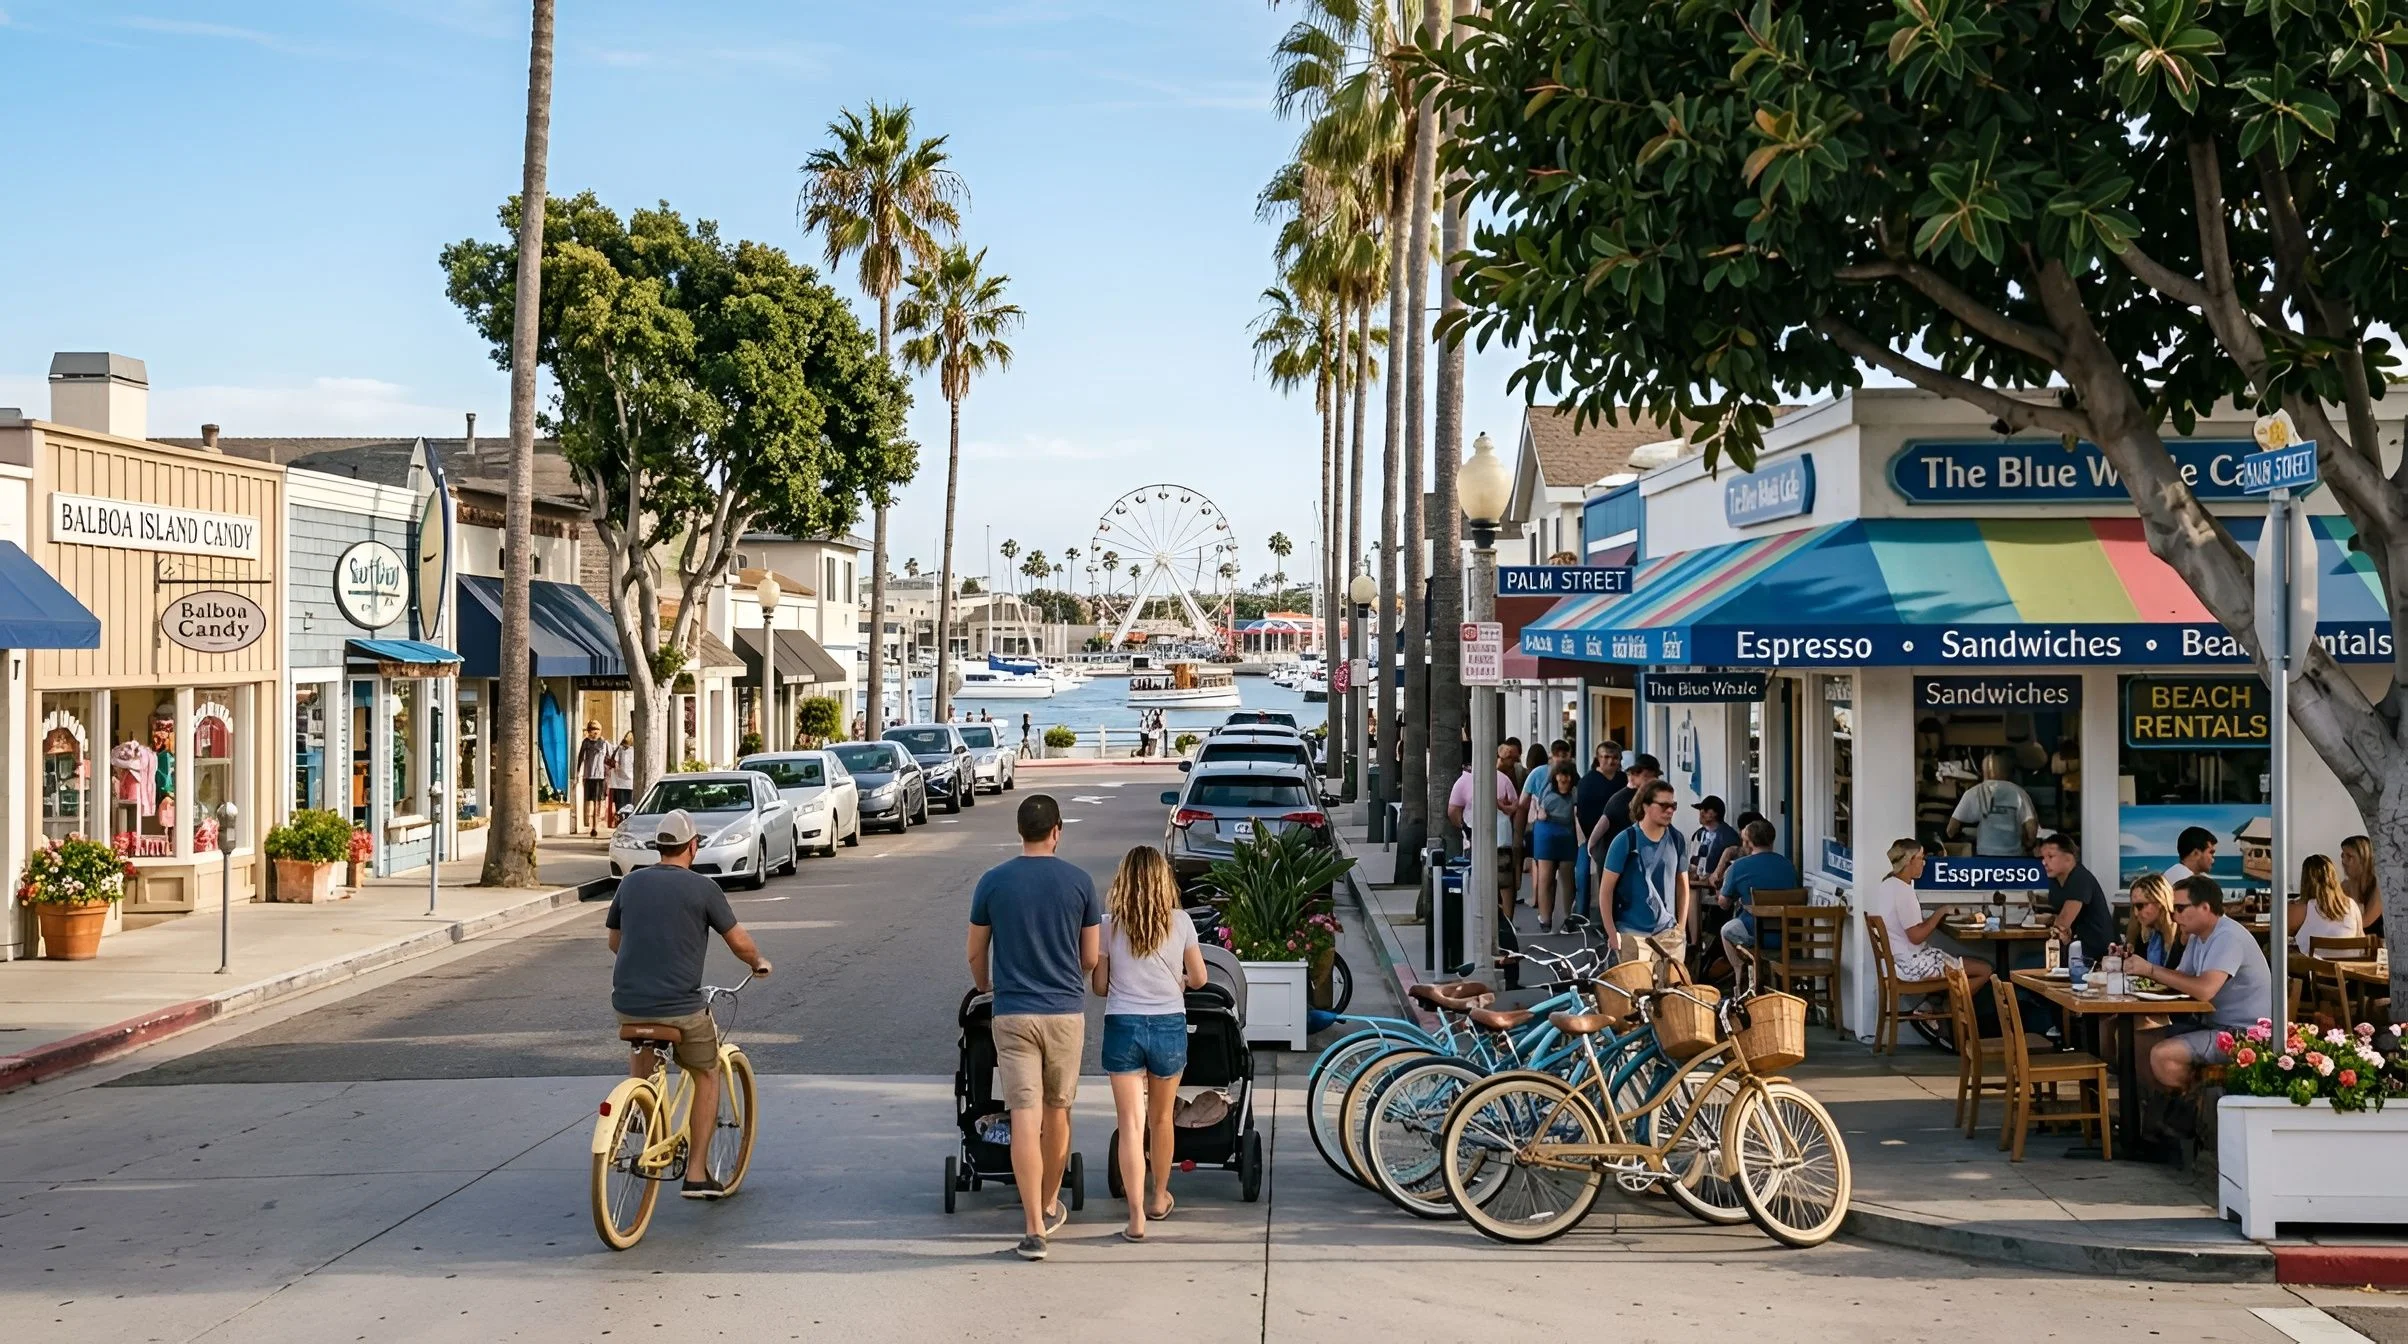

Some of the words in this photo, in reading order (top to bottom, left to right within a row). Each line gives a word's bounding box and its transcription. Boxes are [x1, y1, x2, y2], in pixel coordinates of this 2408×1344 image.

[1921, 456, 1986, 488] The
[1999, 456, 2077, 488] Blue
[62, 503, 133, 538] BALBOA
[140, 511, 198, 543] ISLAND
[203, 519, 252, 550] CANDY
[1507, 571, 1552, 590] PALM
[1561, 571, 1626, 590] STREET
[181, 602, 247, 619] Balboa
[178, 620, 249, 642] Candy
[1737, 631, 1873, 665] Espresso
[1941, 629, 2122, 659] Sandwiches
[2182, 629, 2250, 656] Bea
[2320, 627, 2393, 656] ntals
[1926, 682, 2069, 705] Sandwiches
[2151, 686, 2251, 709] BEACH
[2134, 715, 2269, 739] RENTALS
[1934, 862, 2040, 887] Esspresso
